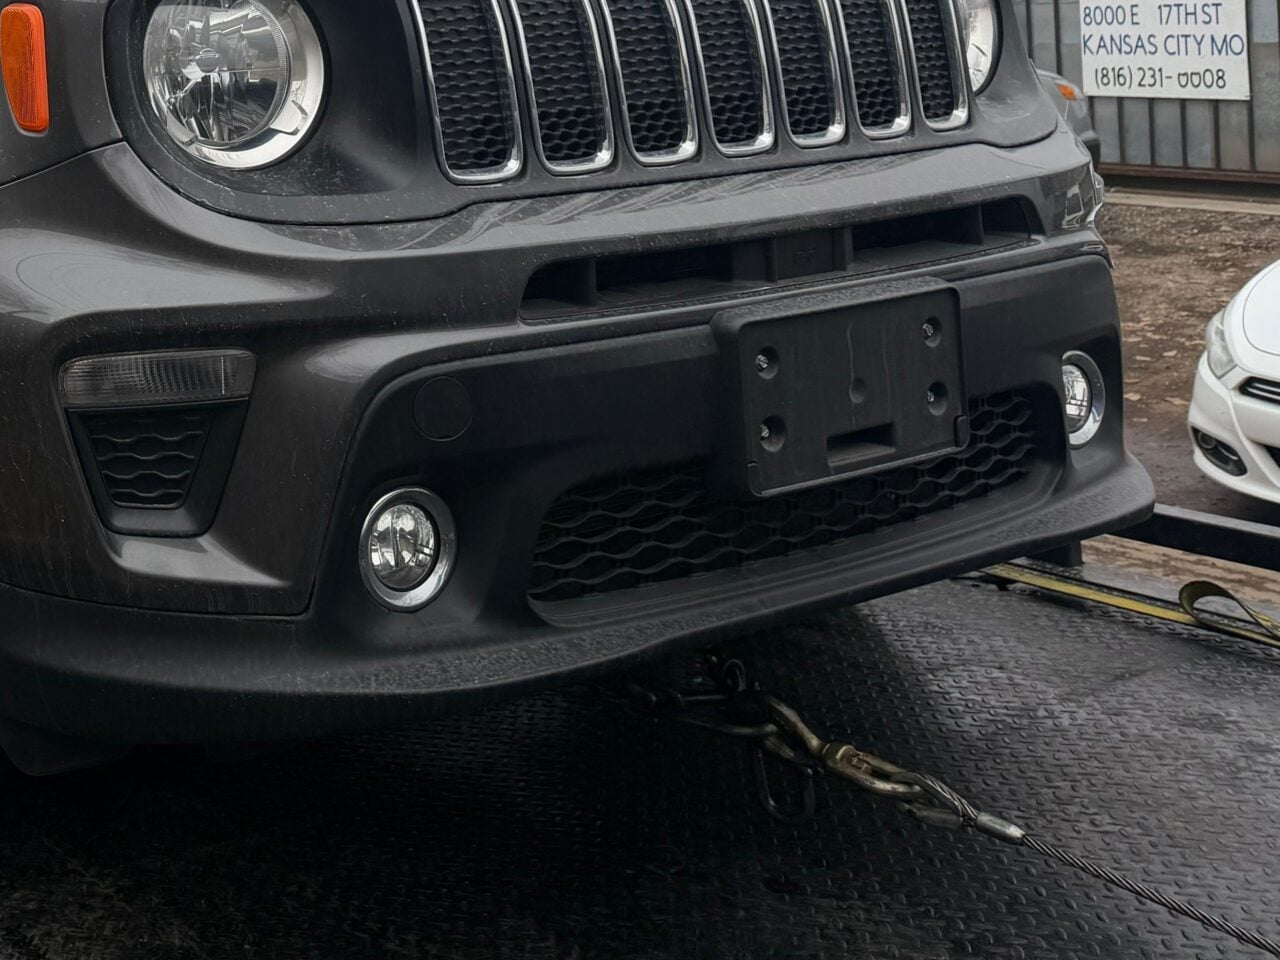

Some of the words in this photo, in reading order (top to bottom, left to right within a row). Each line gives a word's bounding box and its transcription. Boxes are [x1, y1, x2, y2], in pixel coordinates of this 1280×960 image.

[1083, 5, 1126, 26] 8000
[1130, 4, 1140, 25] E
[1157, 3, 1198, 25] 17TH
[1201, 3, 1223, 25] ST
[1083, 34, 1158, 56] KANSAS
[1164, 34, 1205, 56] CITY
[1210, 34, 1245, 56] MO
